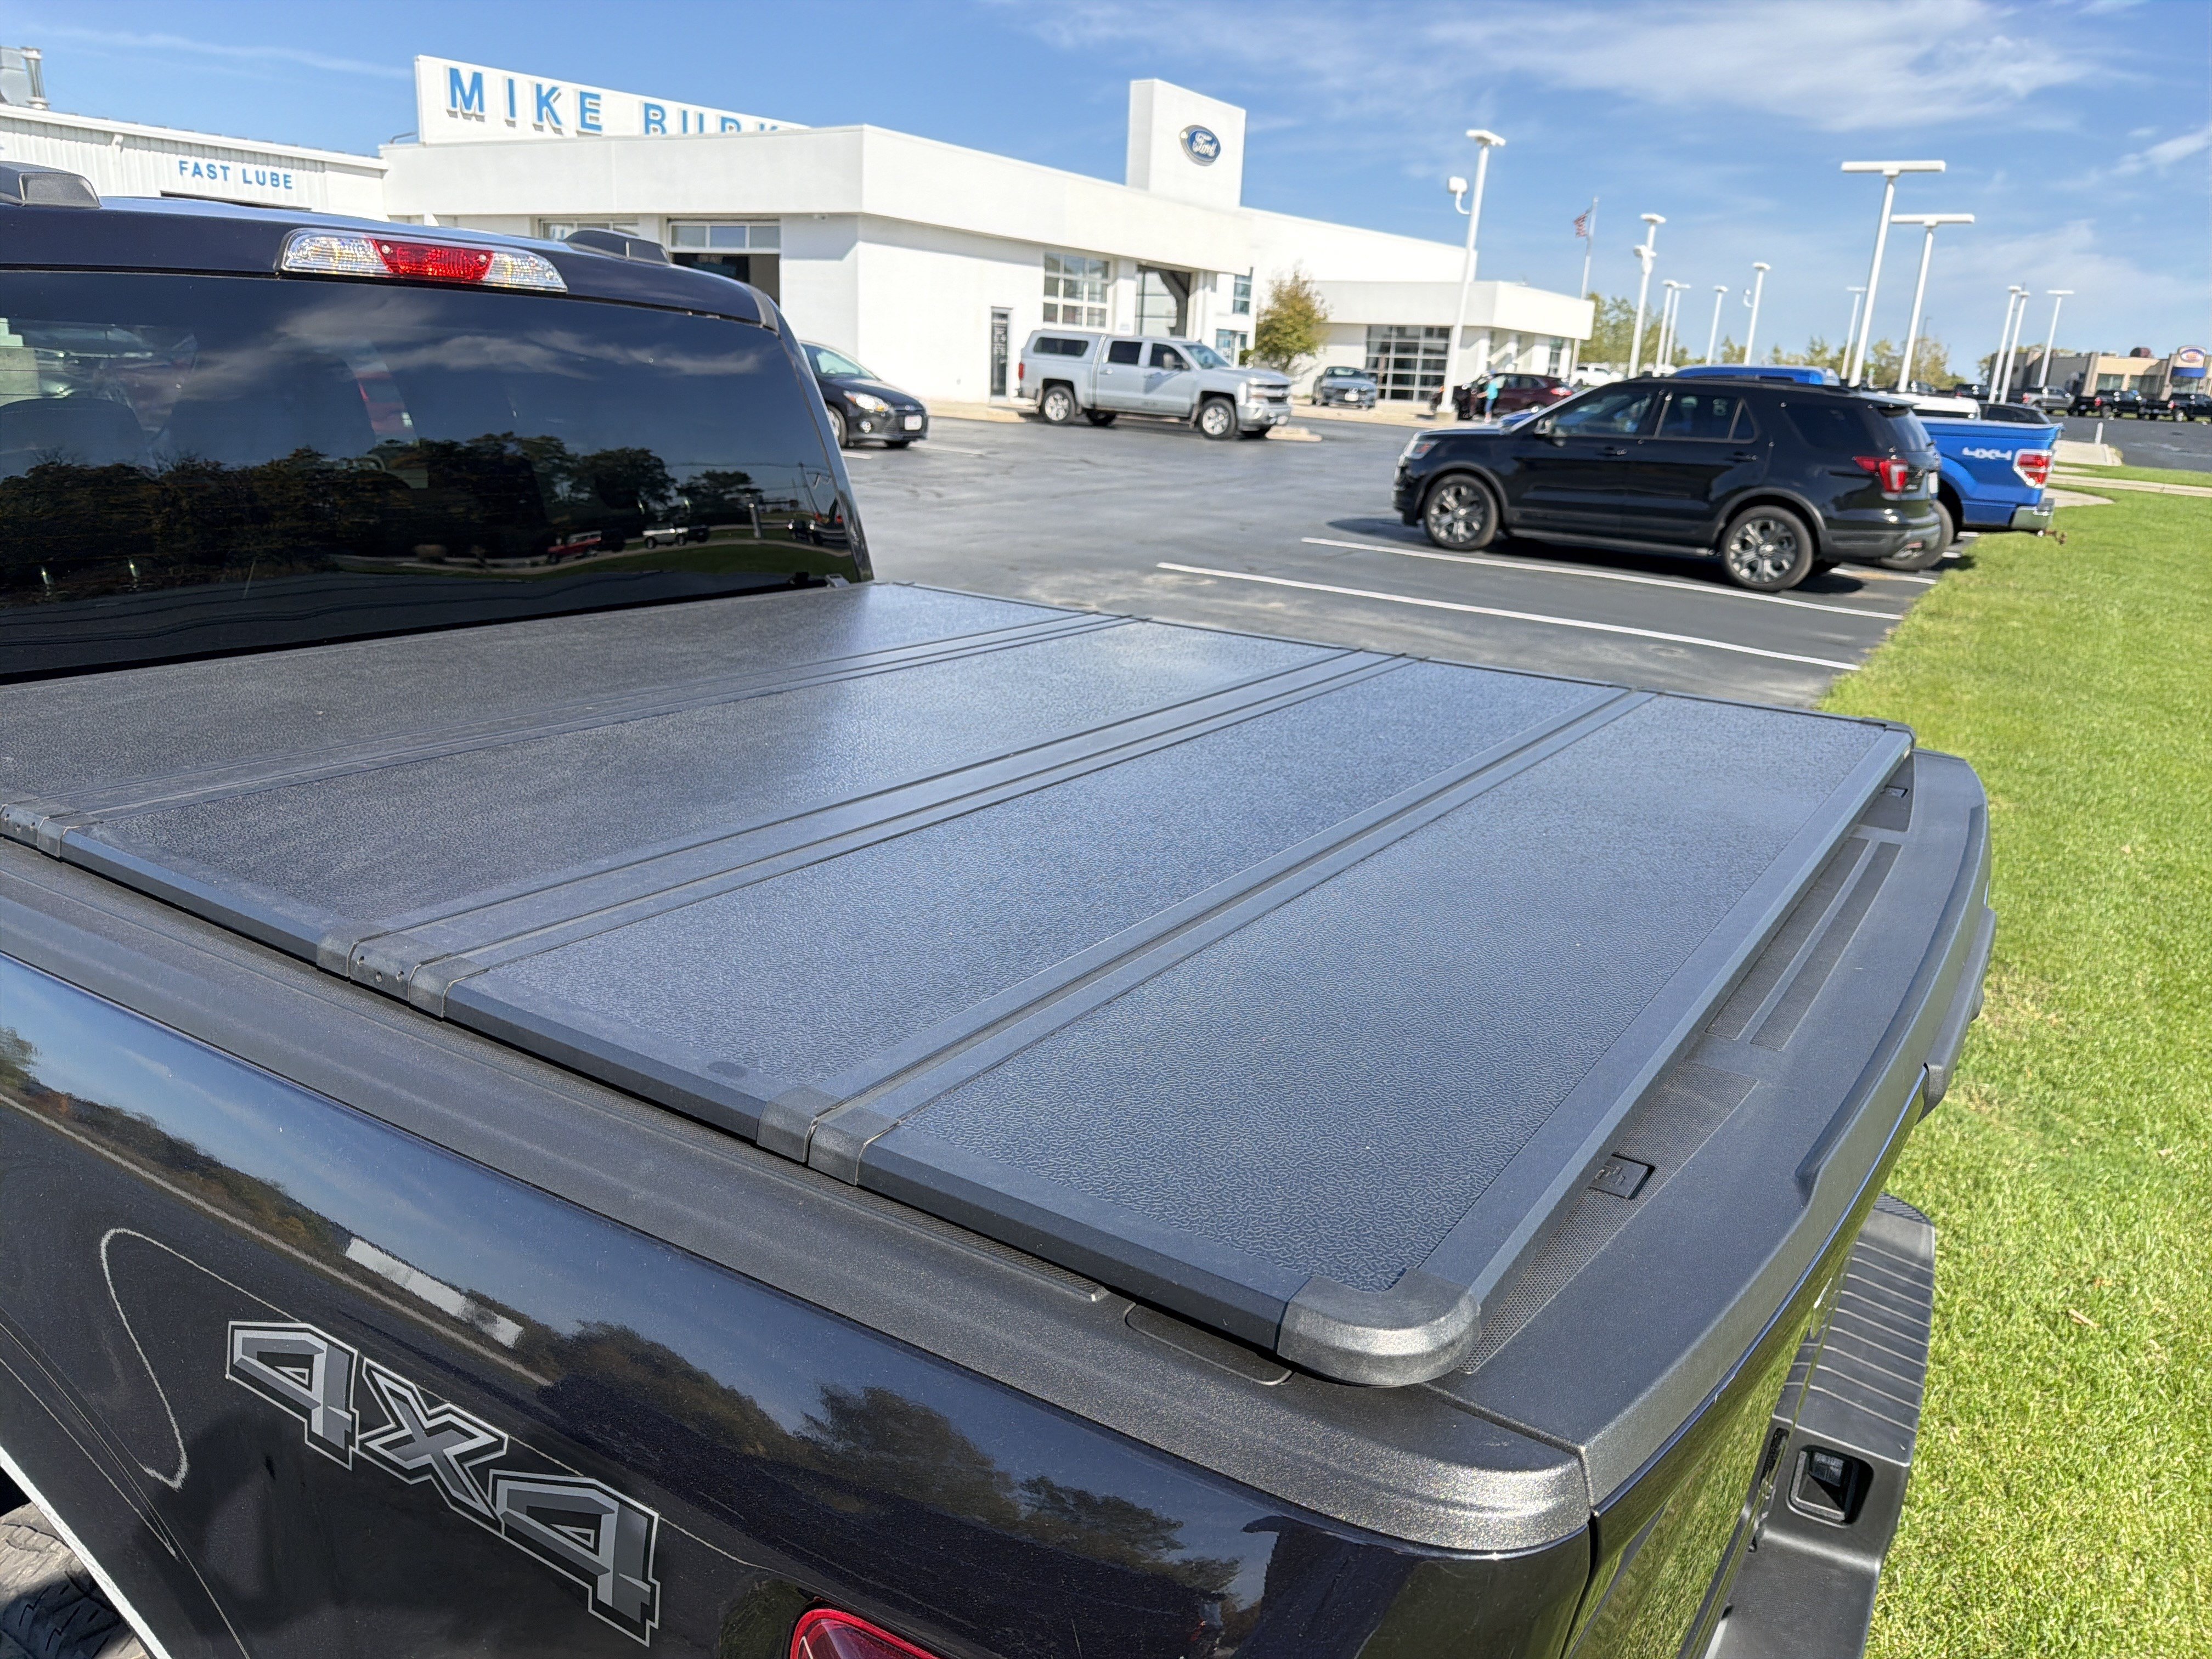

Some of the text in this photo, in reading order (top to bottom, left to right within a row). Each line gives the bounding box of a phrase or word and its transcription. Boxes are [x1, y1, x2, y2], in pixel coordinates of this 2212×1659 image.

[448, 67, 602, 131] MIKE
[179, 160, 292, 189] FAST LUBE
